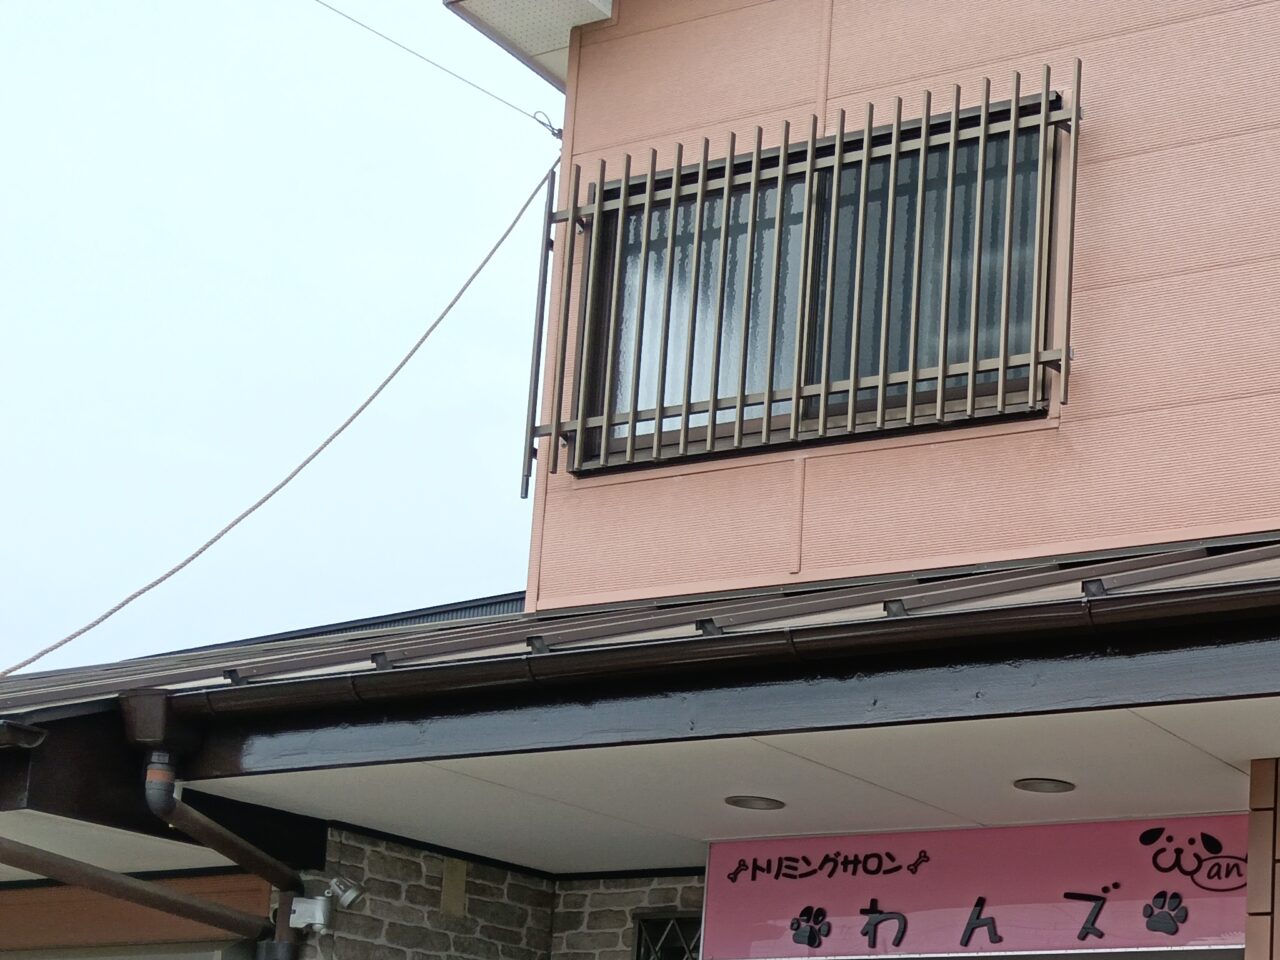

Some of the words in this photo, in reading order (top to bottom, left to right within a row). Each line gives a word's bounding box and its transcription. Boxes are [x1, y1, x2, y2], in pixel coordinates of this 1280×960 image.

[751, 852, 902, 881] トリミングサロン
